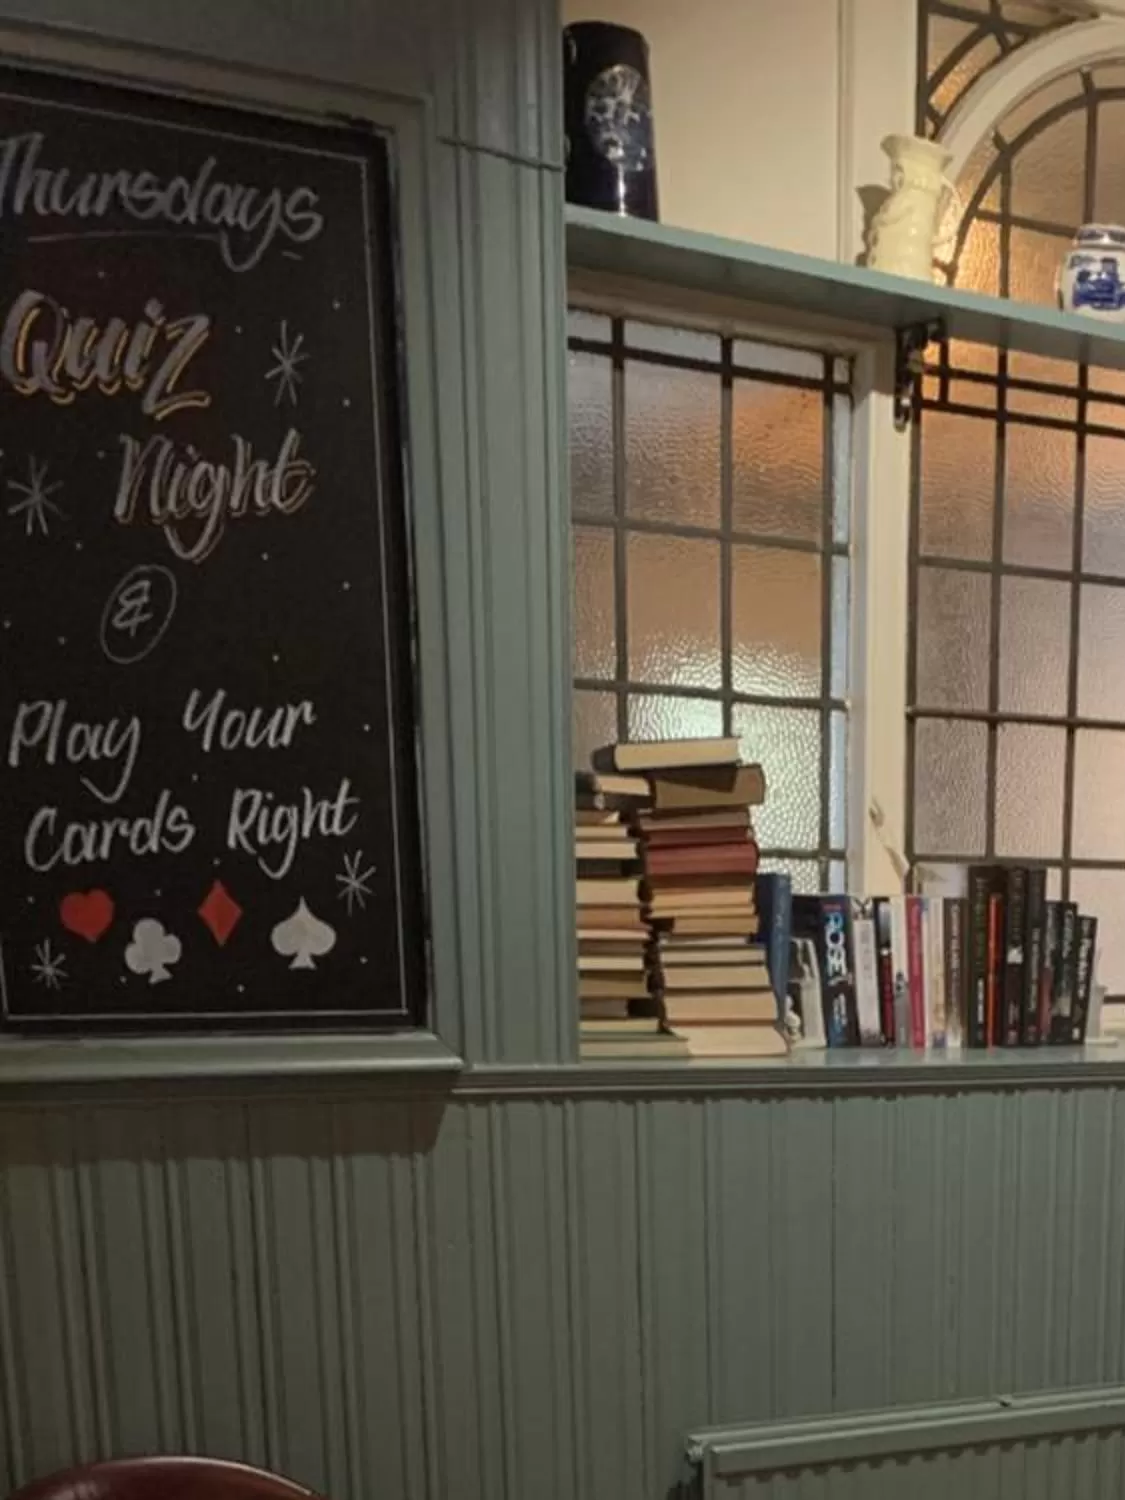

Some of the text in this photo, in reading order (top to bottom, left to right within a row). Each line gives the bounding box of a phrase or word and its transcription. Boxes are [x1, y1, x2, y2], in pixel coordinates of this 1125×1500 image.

[0, 131, 324, 272] Thursdays
[0, 289, 211, 420] Quiz
[113, 427, 316, 563] Night
[8, 688, 317, 803] Play Your
[25, 777, 360, 880] Cards Right
